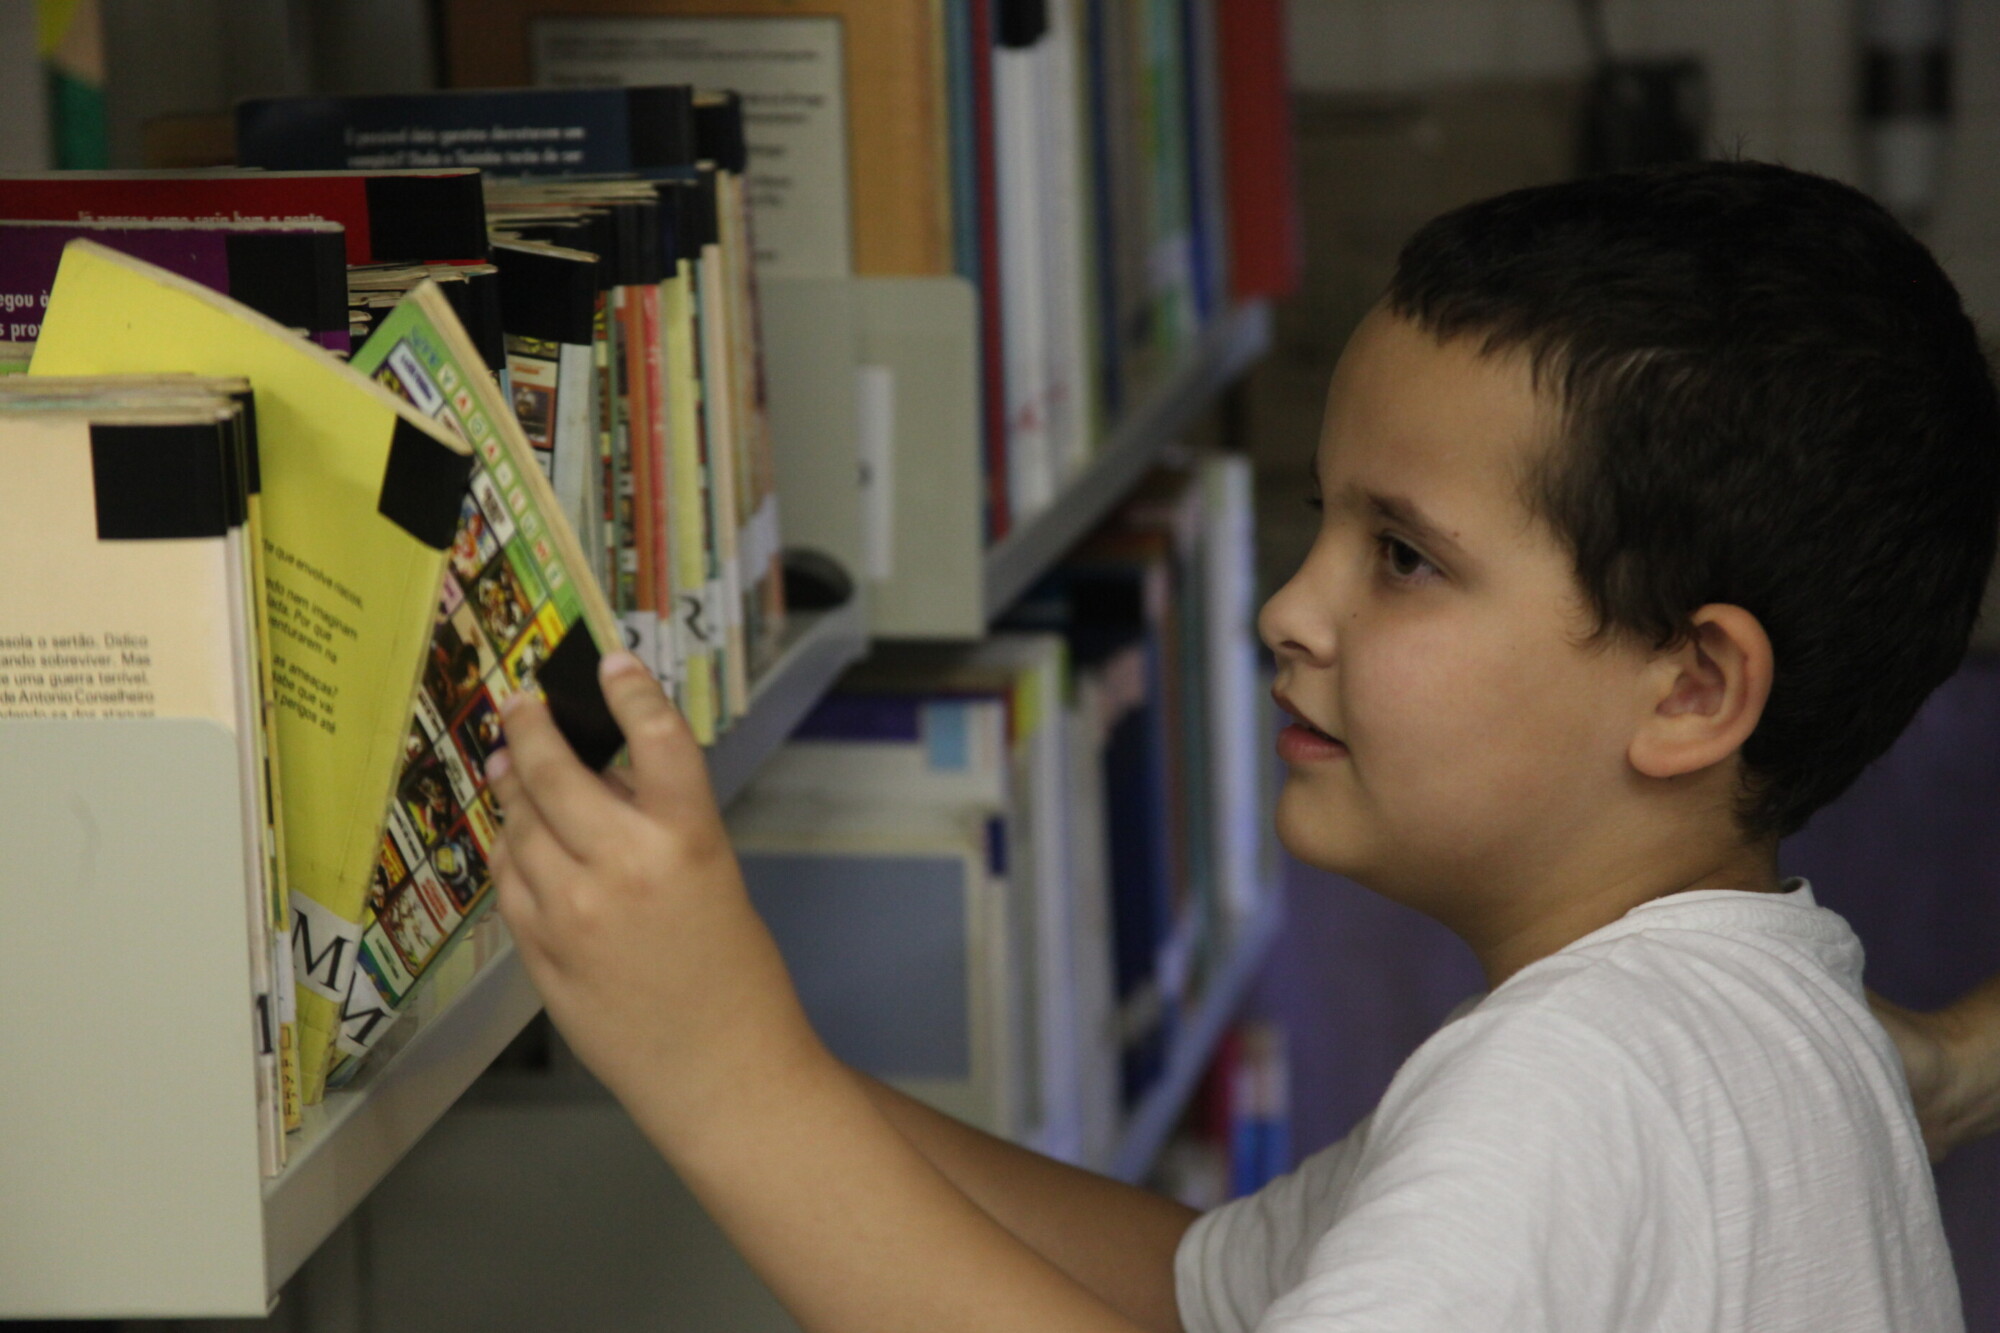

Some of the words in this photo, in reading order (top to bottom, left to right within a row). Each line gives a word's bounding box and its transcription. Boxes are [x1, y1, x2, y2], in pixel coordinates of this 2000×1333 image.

[276, 547, 295, 566] que
[313, 623, 333, 643] que
[121, 651, 151, 667] Mas
[298, 686, 317, 705] que
[291, 906, 354, 993] M
